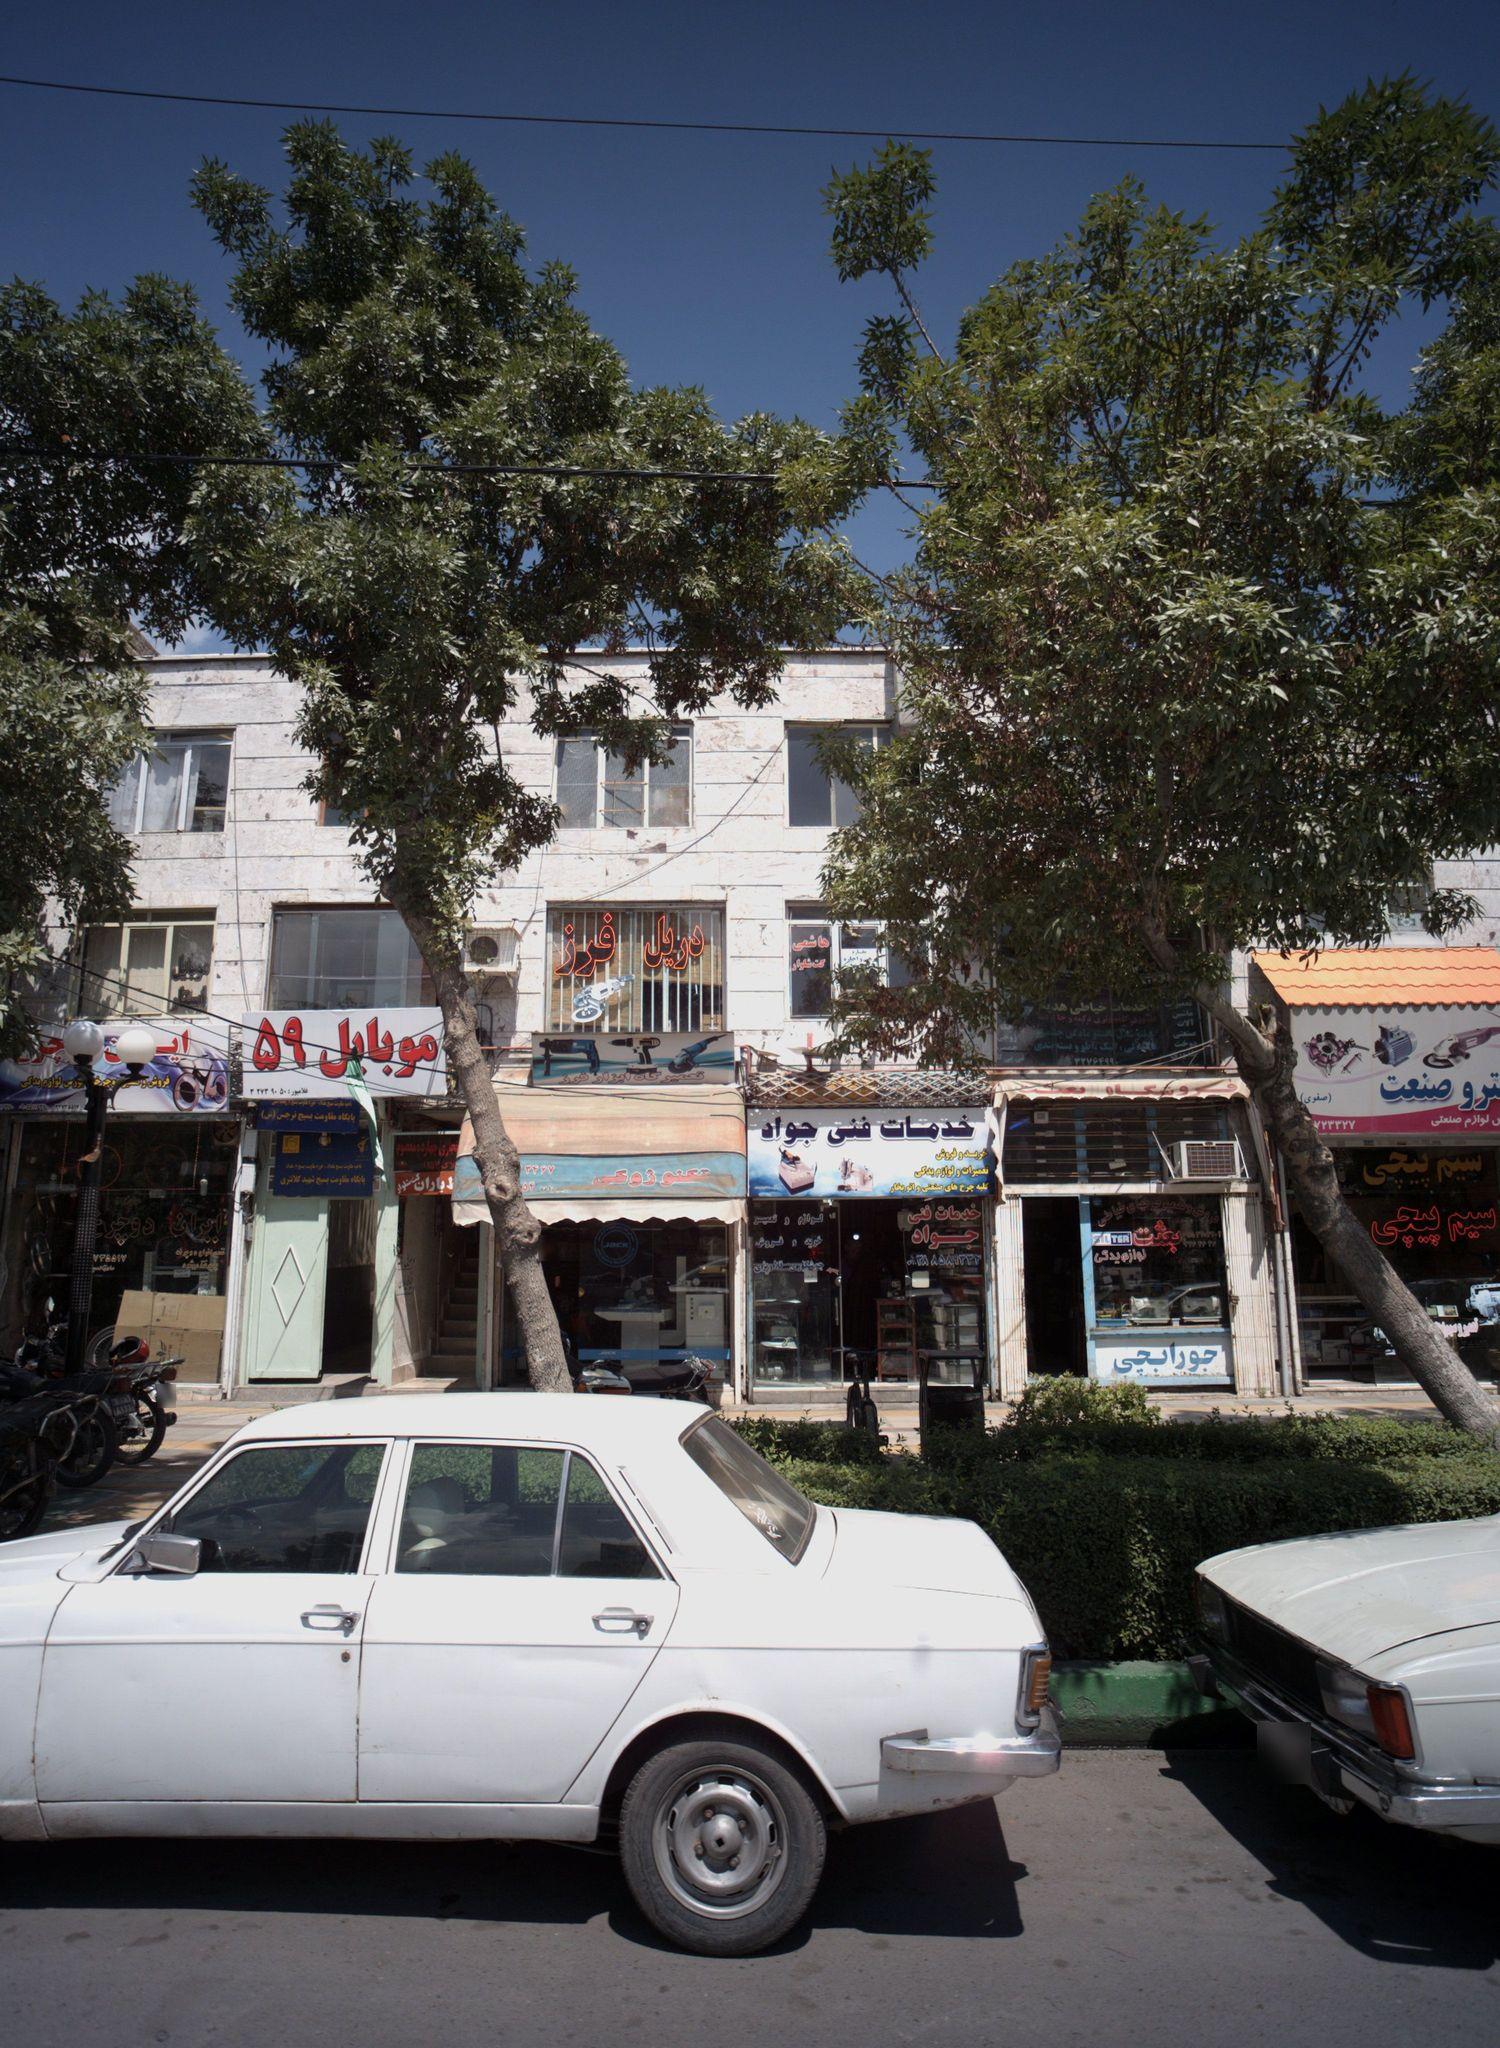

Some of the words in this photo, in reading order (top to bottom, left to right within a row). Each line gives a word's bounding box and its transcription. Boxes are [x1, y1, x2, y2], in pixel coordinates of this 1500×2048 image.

[554, 912, 617, 977] فرز
[644, 913, 704, 970] دریل
[252, 1016, 307, 1072] ۵۹
[319, 1016, 439, 1079] موبایل
[1300, 1092, 1332, 1105] (صفوی)
[1379, 1072, 1453, 1101] صنعت
[761, 1116, 818, 1147] جواد
[827, 1116, 872, 1145] فنی
[880, 1114, 975, 1141] خدمات
[1314, 1119, 1356, 1131] ۷۲۳۳۲۷
[1431, 1115, 1462, 1127] صنعتی
[1464, 1114, 1490, 1128] لوازم
[935, 1147, 957, 1160] فروش
[963, 1147, 987, 1160] خرید
[914, 1166, 935, 1178] یدکی
[936, 1165, 955, 1178] لوازم
[961, 1166, 989, 1177] تعمیرات
[1363, 1151, 1430, 1189] پیچی
[1436, 1152, 1483, 1183] سیم
[907, 1204, 933, 1225] فنی
[934, 1202, 982, 1221] خدمات
[1447, 1207, 1497, 1242] سیم
[911, 1223, 980, 1250] جواد
[1370, 1204, 1441, 1249] پیچی
[1093, 1249, 1121, 1265] یدکی
[1120, 1248, 1148, 1264] لوازم
[1113, 1341, 1218, 1376] جورابچی
